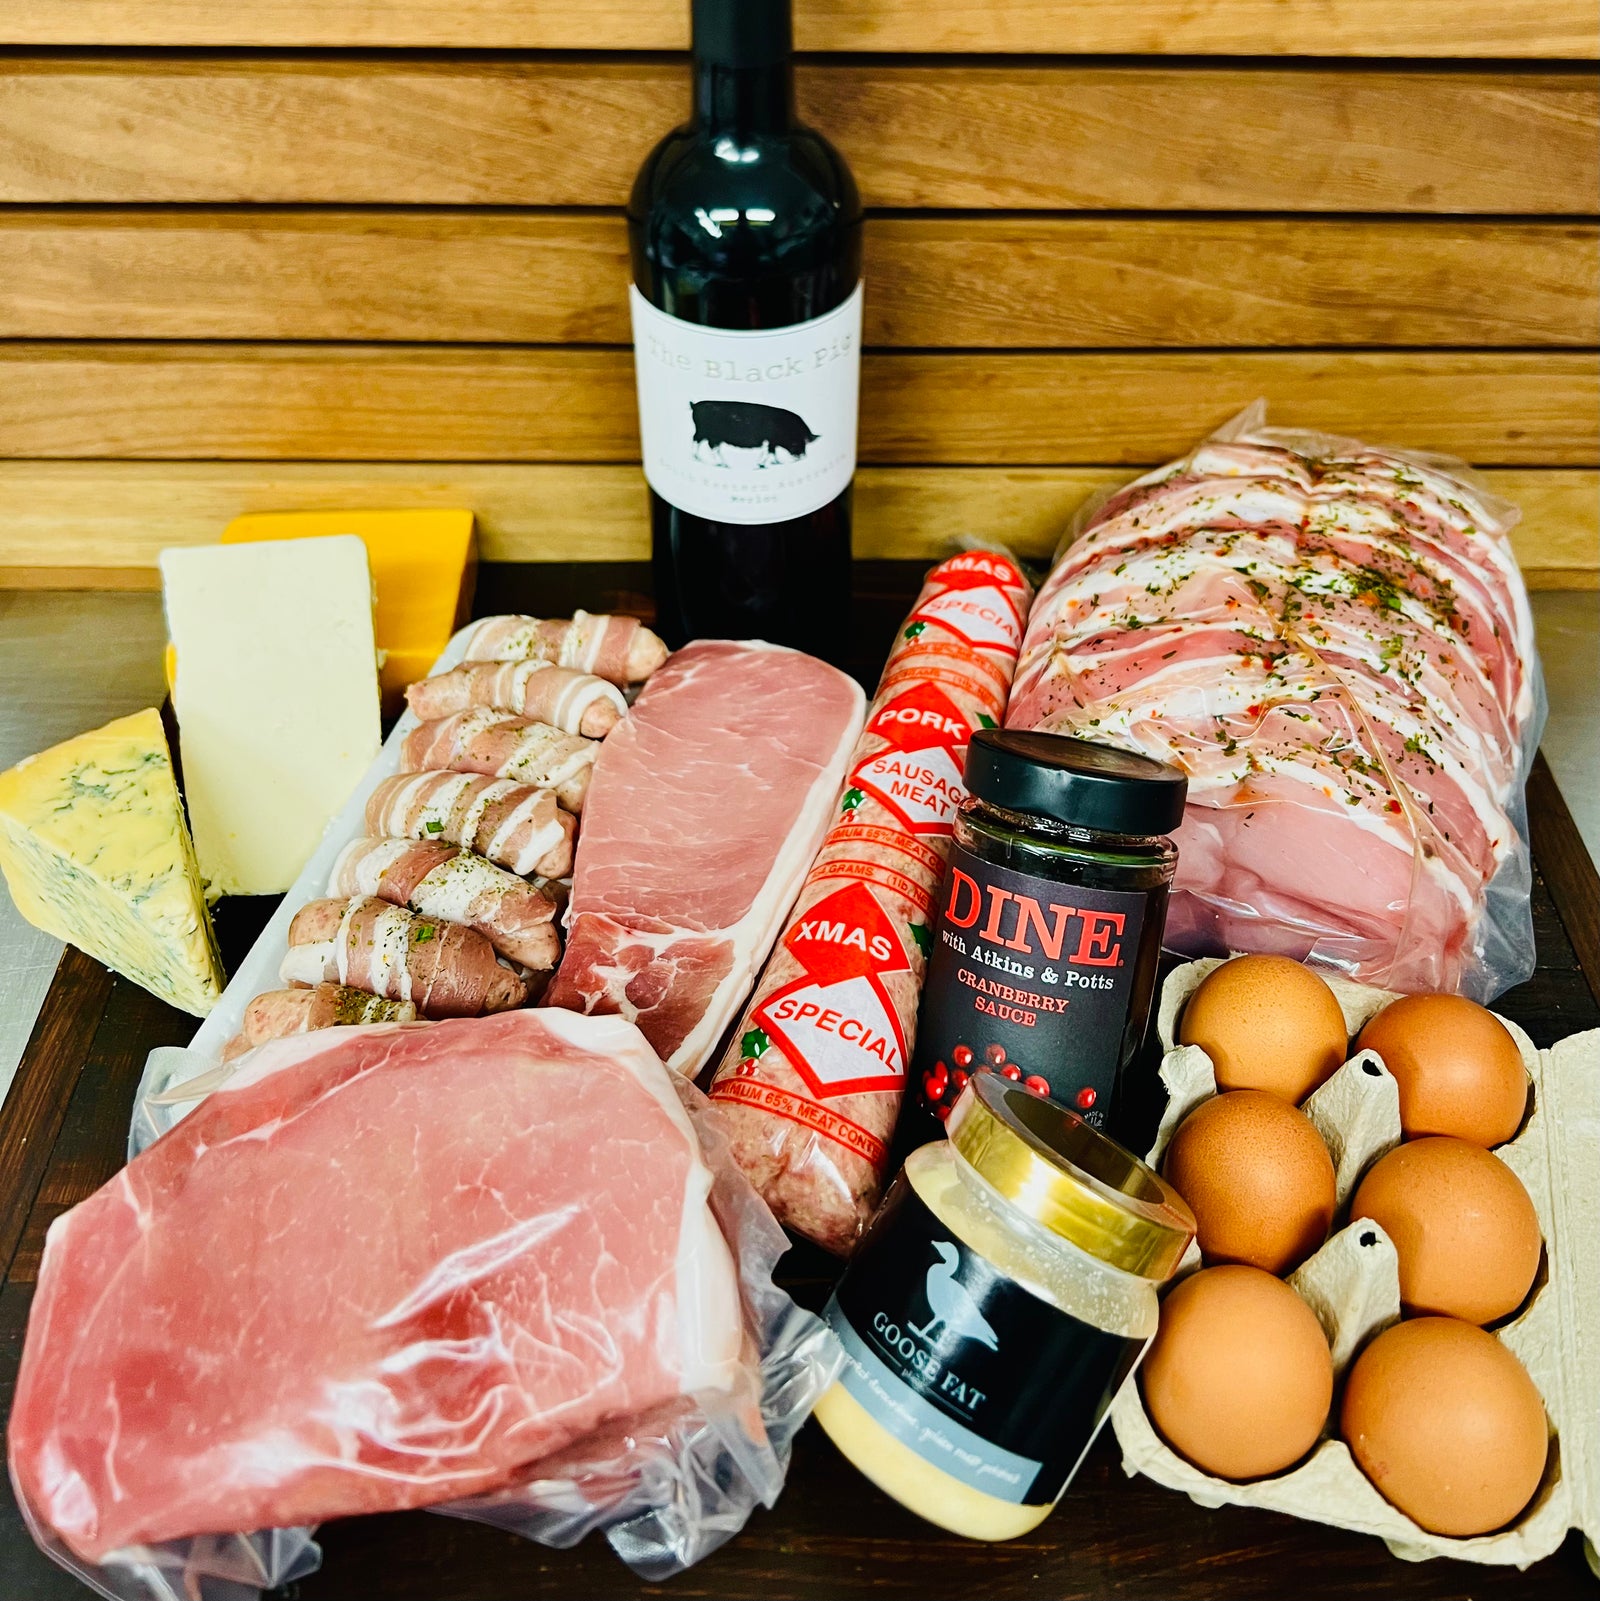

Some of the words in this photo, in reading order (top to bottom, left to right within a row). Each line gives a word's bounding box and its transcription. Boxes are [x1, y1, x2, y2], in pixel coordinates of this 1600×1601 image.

[703, 357, 805, 383] Black
[813, 334, 854, 369] Pig
[877, 707, 966, 741] PORK
[873, 759, 966, 806] SAUSAG
[890, 781, 951, 818] MEAT
[828, 863, 875, 877] GRAMS
[894, 836, 929, 861] MEAT
[944, 866, 1126, 968] DINE
[794, 920, 893, 961] XMAS
[942, 929, 967, 955] with
[971, 945, 1035, 979] Atkins
[1040, 967, 1059, 985] &
[1064, 970, 1114, 990] Potts
[957, 968, 1070, 1014] CRANBERRY
[974, 996, 1037, 1028] SAUCE
[773, 999, 898, 1073] SPECIAL
[765, 1090, 794, 1112] 65%
[796, 1103, 838, 1135] MEAT
[838, 1124, 881, 1162] CONTE
[873, 1311, 943, 1380] GOOSE
[940, 1369, 987, 1411] FAT
